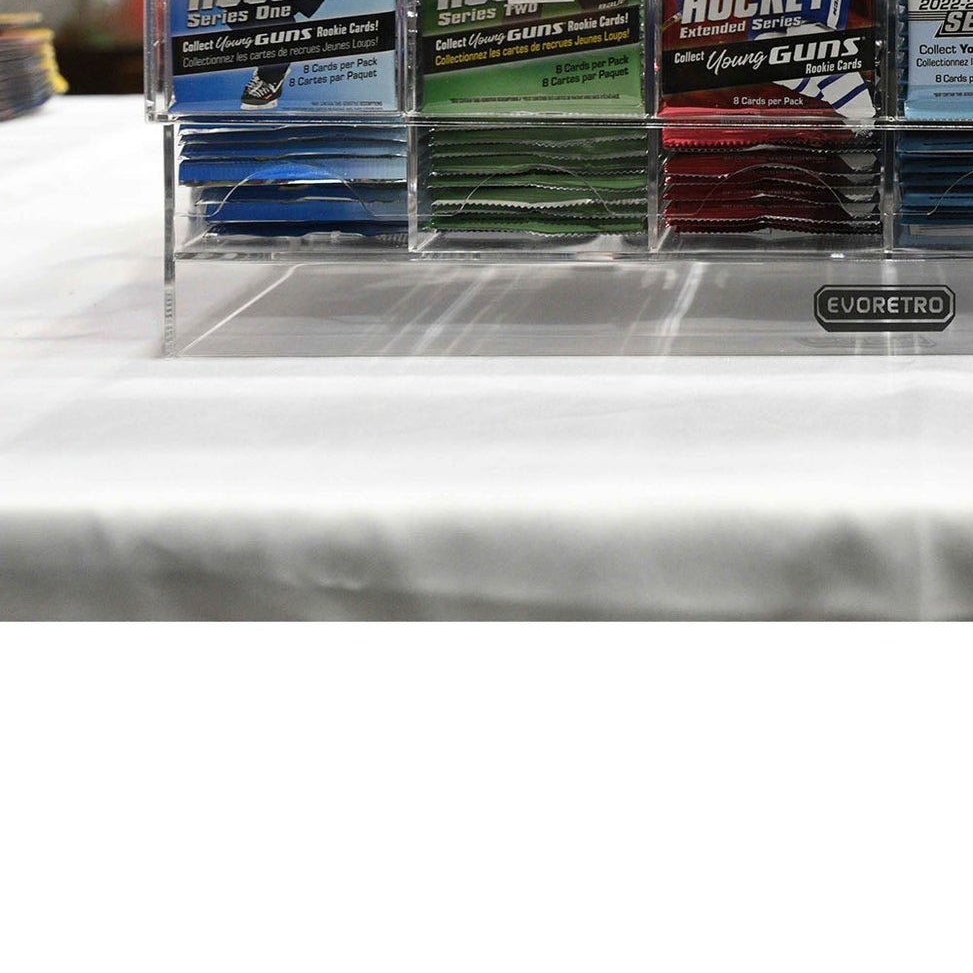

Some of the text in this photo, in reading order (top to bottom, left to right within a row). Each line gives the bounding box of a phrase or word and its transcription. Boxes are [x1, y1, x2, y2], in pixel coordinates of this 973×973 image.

[187, 4, 291, 29] Series One
[438, 7, 497, 27] Series
[435, 37, 467, 51] Collect
[468, 32, 507, 49] Young
[567, 18, 598, 32] Rookie
[599, 12, 628, 27] Cards!
[679, 15, 802, 39] Extended Series
[182, 39, 213, 53] Collect
[215, 34, 253, 54] Young
[316, 23, 347, 38] Rookie
[349, 20, 379, 35] Cards!
[182, 36, 379, 68] Collectionnez les cartes de recrues Jeunes Loups!
[435, 30, 630, 66] Collectionnez les cartes de recrues Jeunes Loups!
[919, 43, 957, 55] Collect
[303, 57, 378, 74] 8 Cards per Pack
[555, 55, 630, 74] 8 Cards per Pack
[674, 51, 705, 64] Collect
[705, 48, 769, 76] Young
[805, 58, 862, 75] Rookie Cards
[916, 58, 969, 67] Collectionnez
[289, 69, 378, 87] 8 Cartes par Paquet
[542, 68, 630, 87] 8 Cartes par Paquet
[935, 74, 942, 83] 8
[943, 74, 967, 83] Cards
[733, 96, 804, 107] 8 Cards per Pack
[827, 296, 944, 314] EVORETRO
